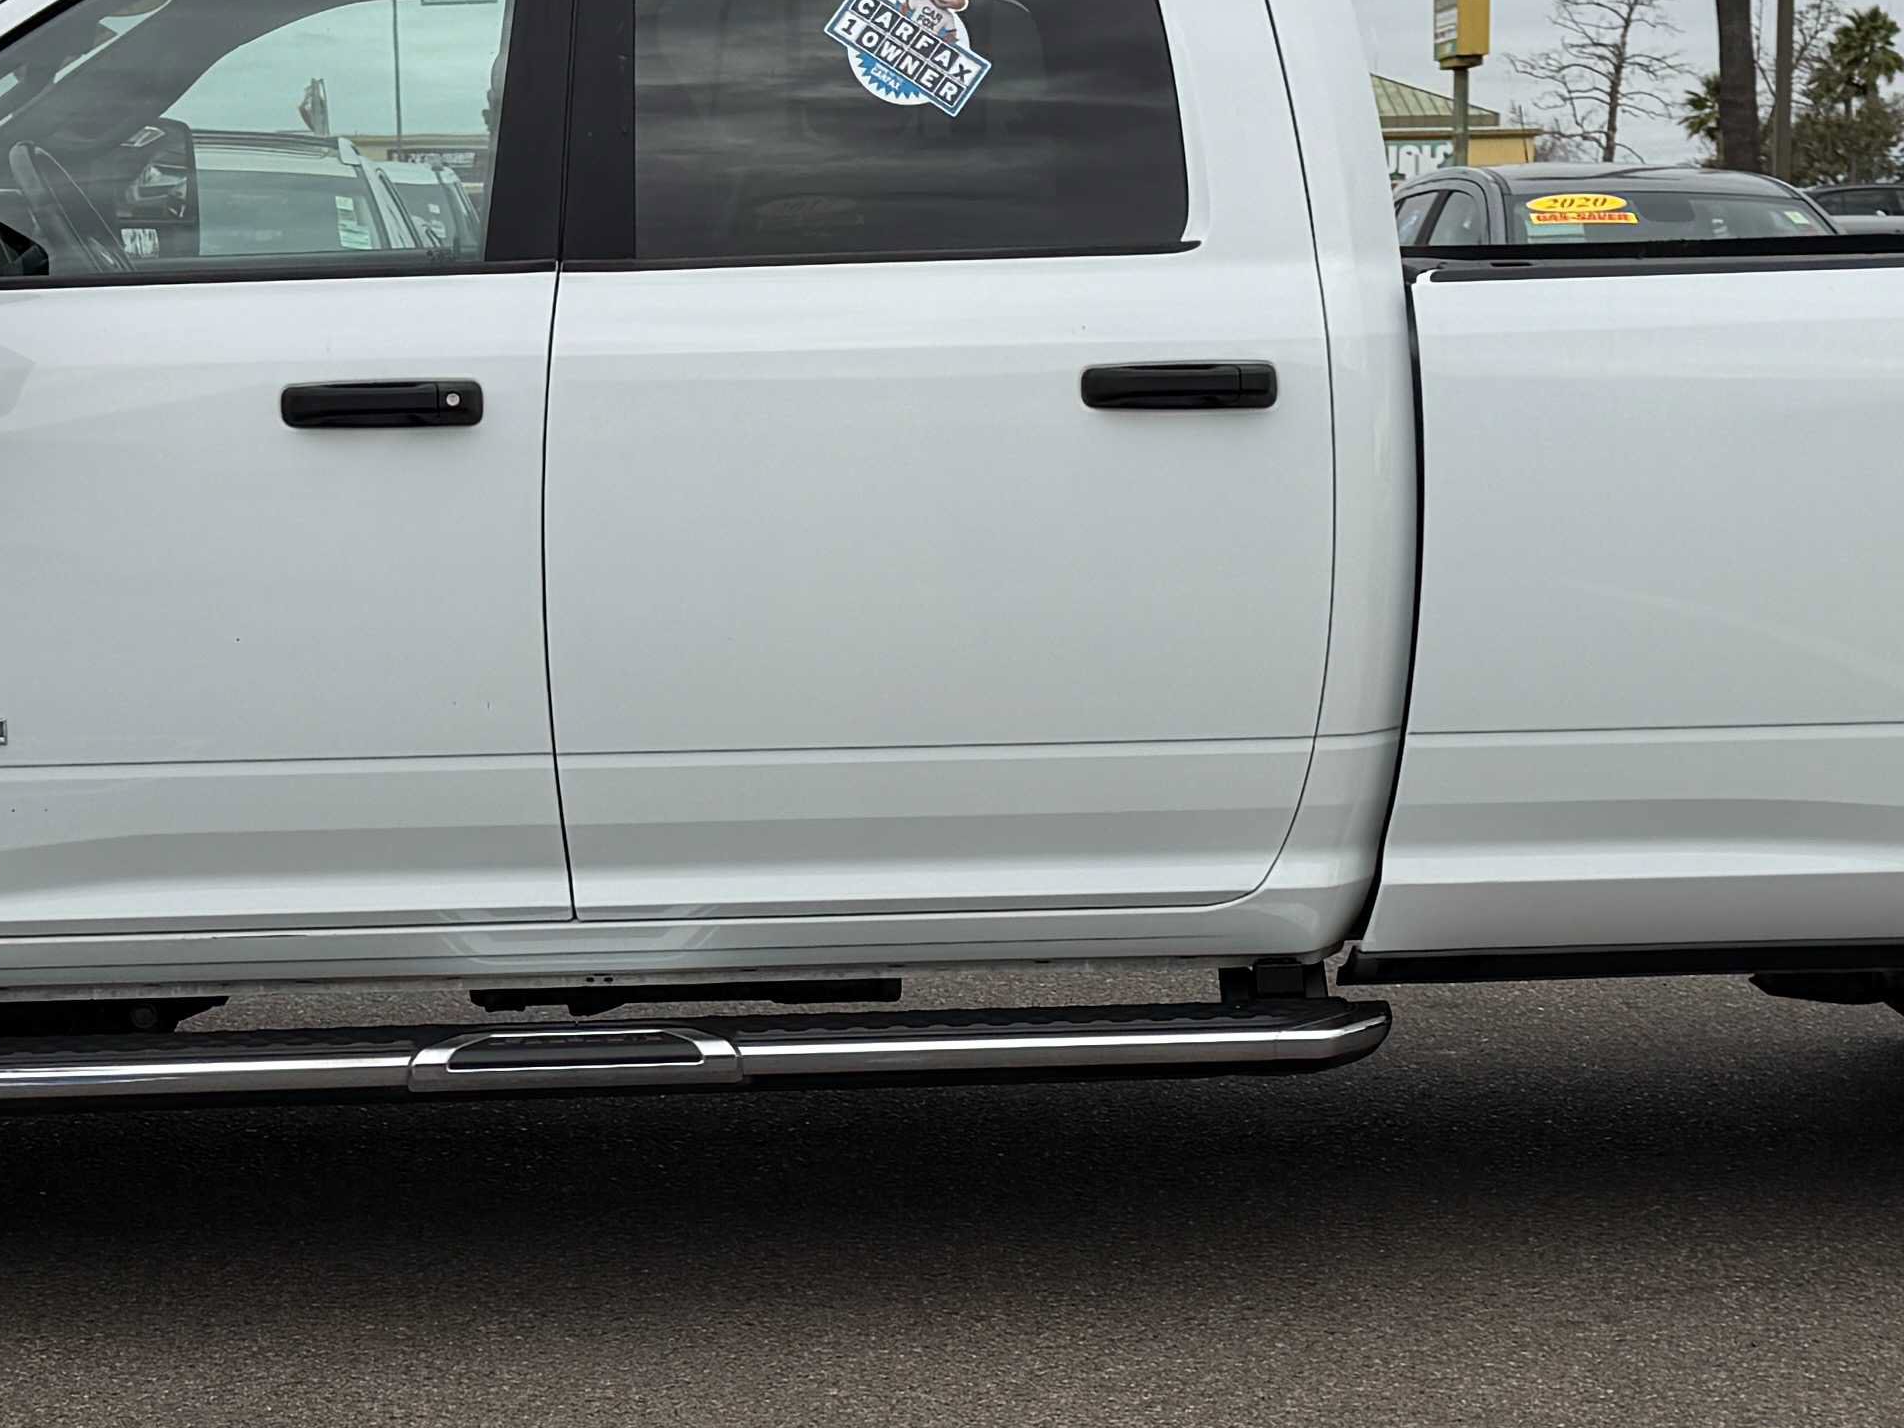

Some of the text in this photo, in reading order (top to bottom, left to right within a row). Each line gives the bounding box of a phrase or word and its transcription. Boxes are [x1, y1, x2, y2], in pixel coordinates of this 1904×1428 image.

[841, 19, 857, 35] 1
[861, 33, 959, 102] OWNER
[1546, 196, 1609, 209] 2020
